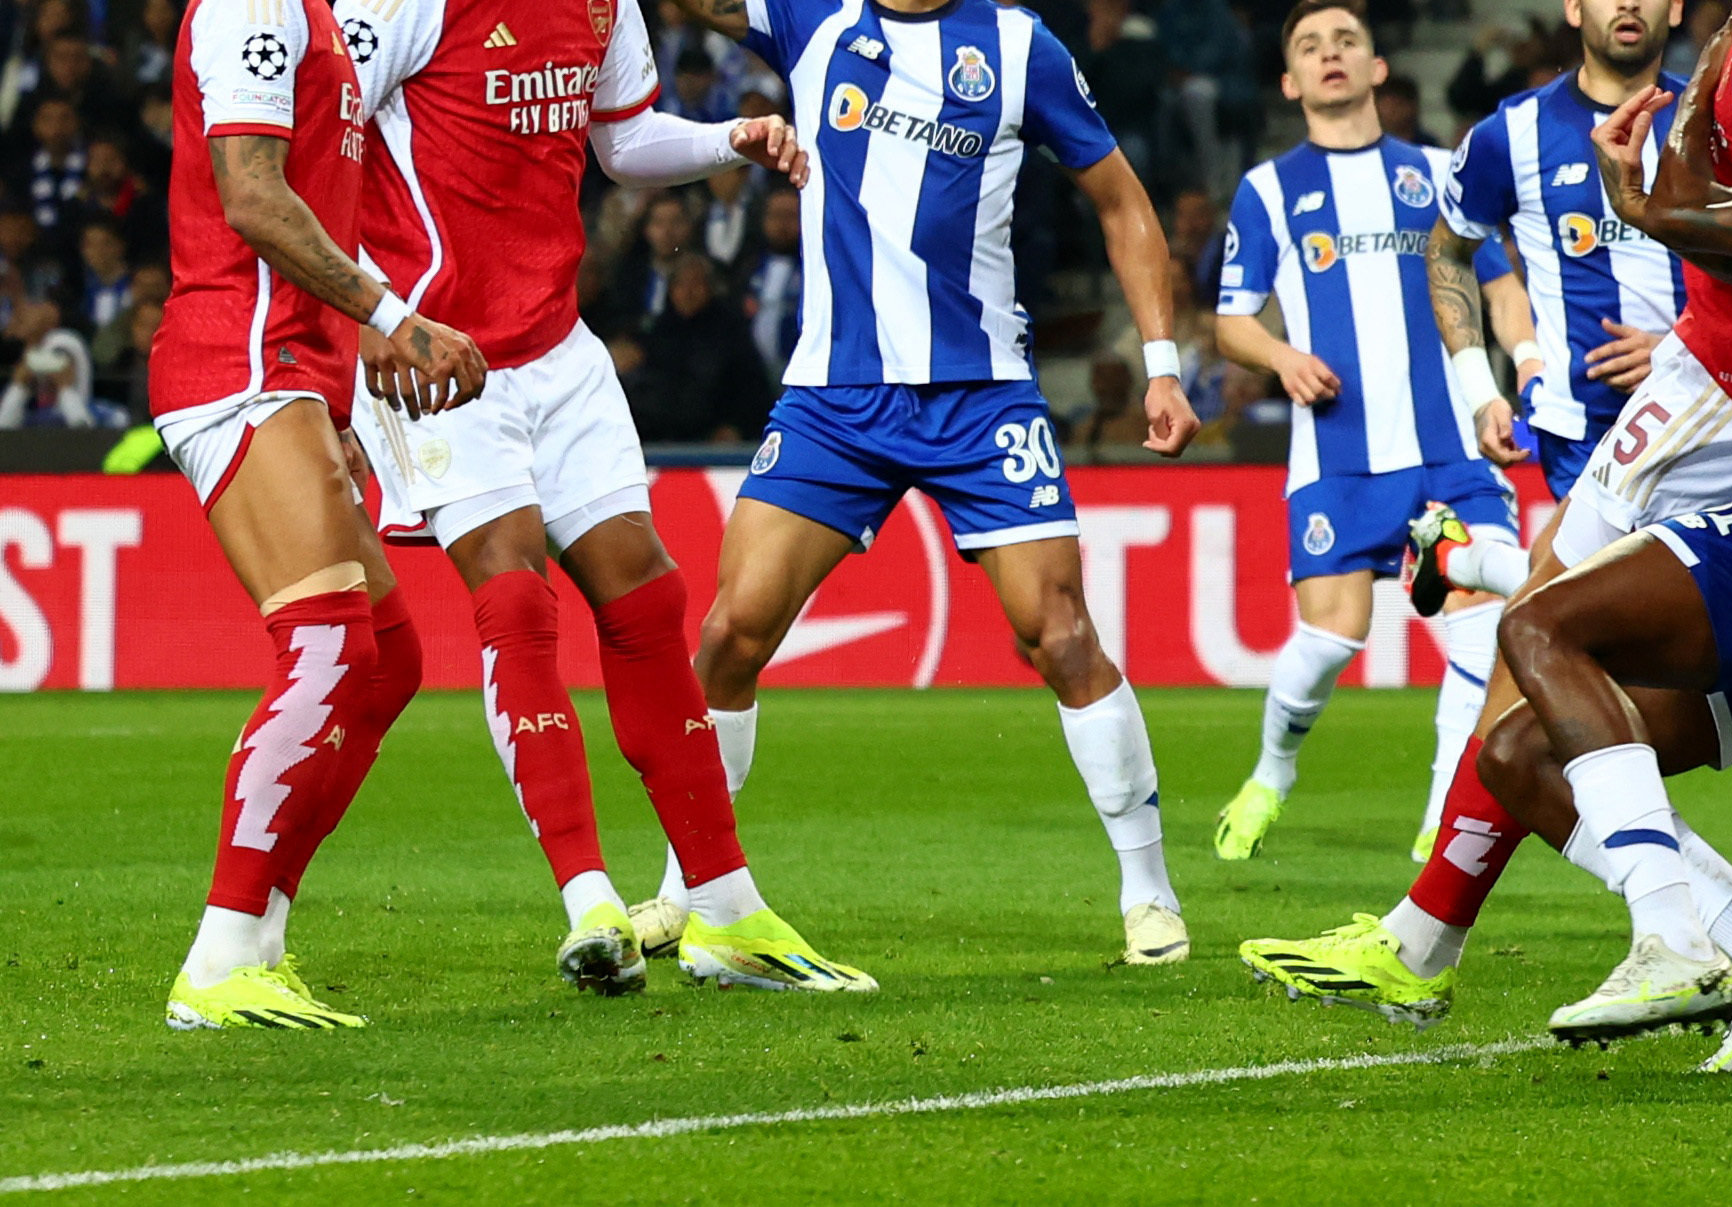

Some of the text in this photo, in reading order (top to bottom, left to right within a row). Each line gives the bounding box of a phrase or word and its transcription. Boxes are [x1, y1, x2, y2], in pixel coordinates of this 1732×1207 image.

[484, 60, 600, 105] Emirate
[509, 103, 542, 135] FLY
[862, 104, 983, 159] BETANO
[994, 416, 1062, 484] 30
[515, 712, 569, 735] AFC
